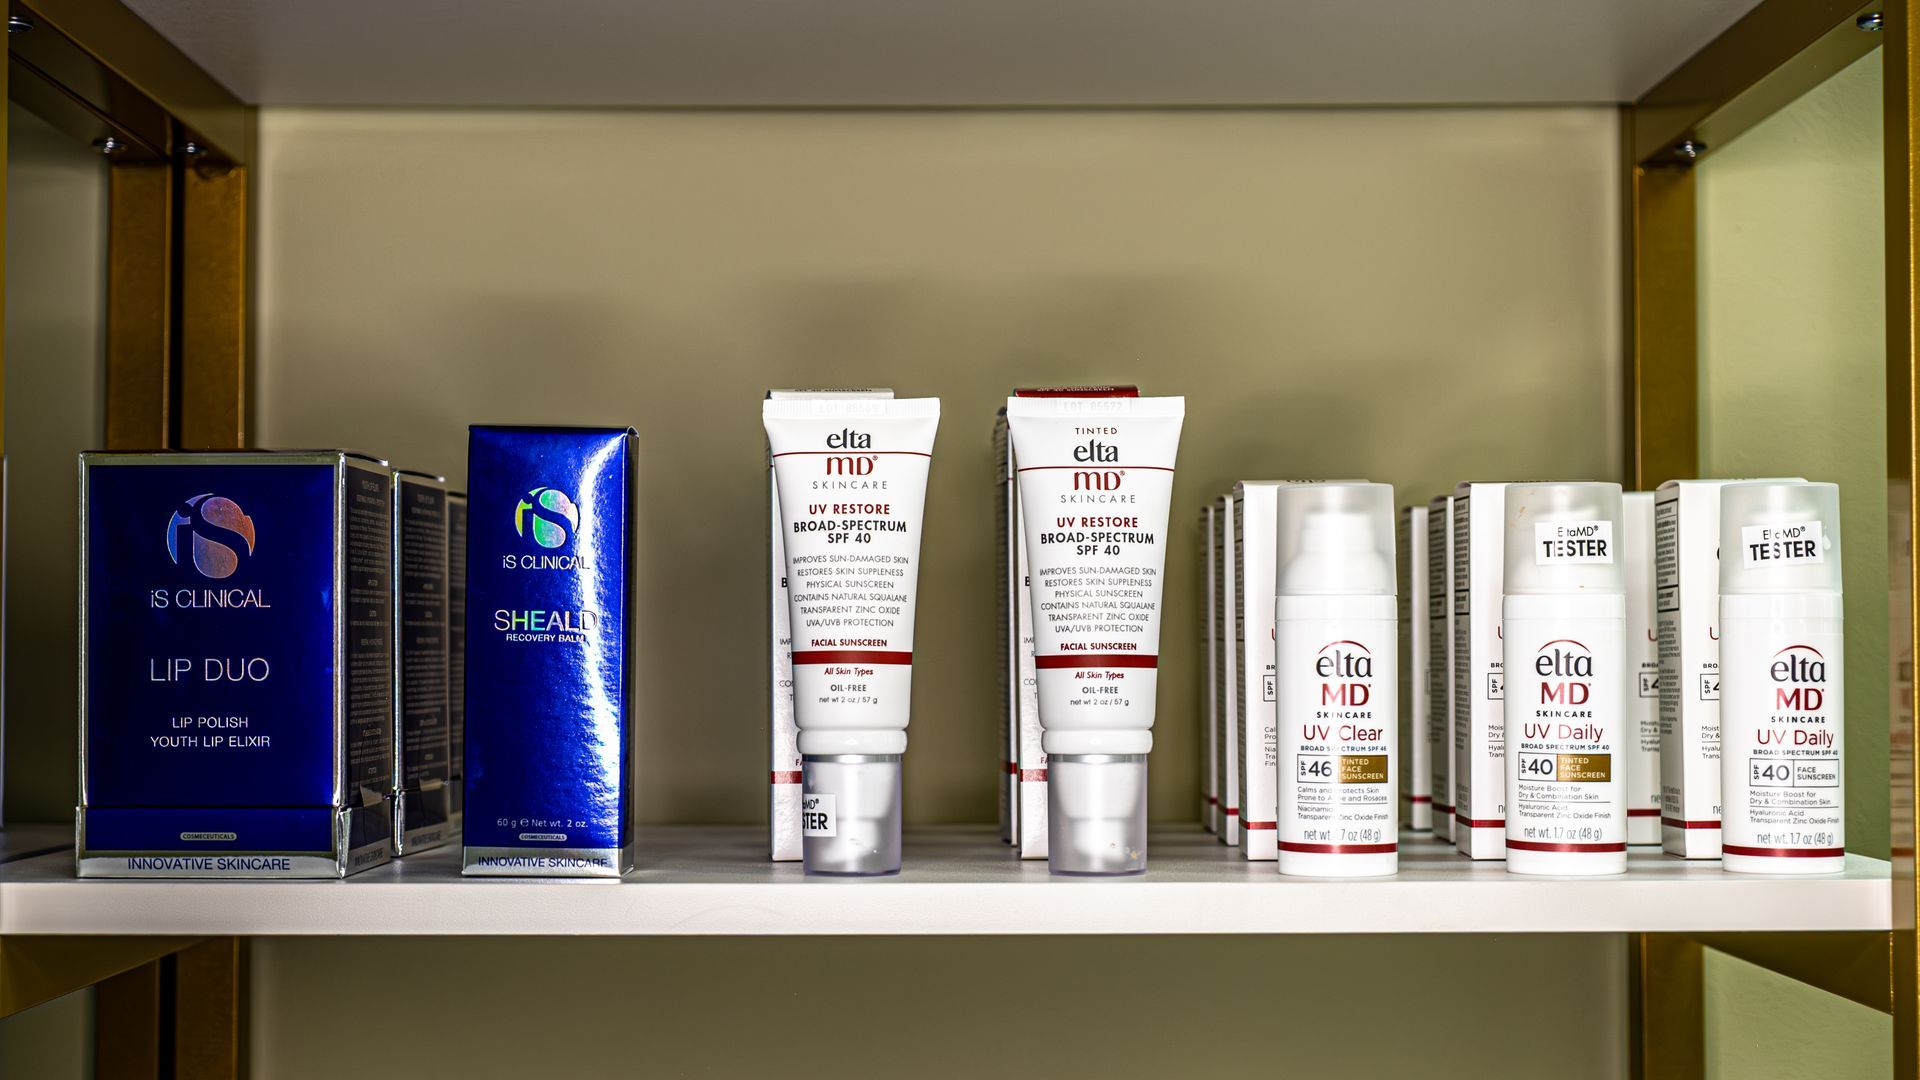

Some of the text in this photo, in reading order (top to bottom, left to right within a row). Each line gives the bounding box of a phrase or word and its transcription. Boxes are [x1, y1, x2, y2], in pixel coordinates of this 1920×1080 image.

[827, 428, 871, 449] elta
[1074, 440, 1118, 462] elta
[812, 481, 888, 489] SKINCARE
[1061, 495, 1136, 503] SKINCARE
[809, 504, 890, 514] UV RESTORE
[794, 521, 907, 532] BROAD-SPECTRUM
[1057, 517, 1138, 528] UV RESTORE
[828, 533, 871, 543] SPF 40
[1041, 533, 1154, 544] BROAD-SPECTRUM
[1076, 545, 1120, 555] SPF 40
[1543, 540, 1607, 557] TESTER
[1750, 540, 1816, 560] TESTER
[503, 556, 590, 569] iS CLINICAL
[793, 555, 908, 564] IMPROVES SUN-DAMAGED SKIN
[798, 568, 904, 576] RESTORES SKIN SUPPLENESS
[1040, 567, 1156, 576] IMPROVES SUN-DAMAGED SKIN
[807, 581, 894, 589] PHYSICAL SUNSCREEN
[1045, 578, 1152, 587] RESTORES SKIN SUPPLENESS
[150, 590, 270, 608] iS CLINICAL
[794, 594, 829, 602] CONTAINS
[870, 594, 907, 602] SQUALANE
[1055, 590, 1143, 598] PHYSICAL SUNSCREEN
[801, 606, 900, 615] TRANSPARENT ZINC OXIDE
[1041, 602, 1079, 610] CONTAINS
[1120, 602, 1155, 610] SQUALANE
[494, 610, 597, 631] SHEALD
[1129, 613, 1149, 621] OXIDE
[806, 619, 840, 627] UVA/UVB
[1055, 624, 1143, 633] UVA/UVB PROTECTION
[506, 634, 584, 642] RECOVERY BALM
[811, 639, 887, 647] FACIAL SUNSCREEN
[1061, 643, 1087, 651] FACIAL
[1316, 650, 1372, 677] elta
[1536, 649, 1593, 677] elta
[150, 658, 269, 681] LIP DUO
[836, 667, 852, 675] Skin
[854, 668, 873, 676] Types
[1771, 655, 1825, 683] elta
[1087, 671, 1102, 679] Skin
[1105, 672, 1124, 680] Types
[831, 684, 867, 692] OIL-FREE
[172, 717, 248, 728] LIP POLISH
[1304, 725, 1383, 741] UV Clear
[1525, 723, 1603, 743] UV Daily
[150, 736, 270, 747] YOUTH LIP ELIXIR
[1758, 730, 1833, 748] UV Daily
[1309, 761, 1332, 776] 46
[1528, 759, 1553, 775] 40
[1762, 765, 1789, 780] 40
[1519, 803, 1550, 811] Hyaluronic
[532, 819, 547, 827] Net
[550, 819, 563, 827] wt.
[128, 858, 290, 870] INNOVATIVE SKINCARE
[478, 857, 607, 867] INNOVATIVE SKINCARE
